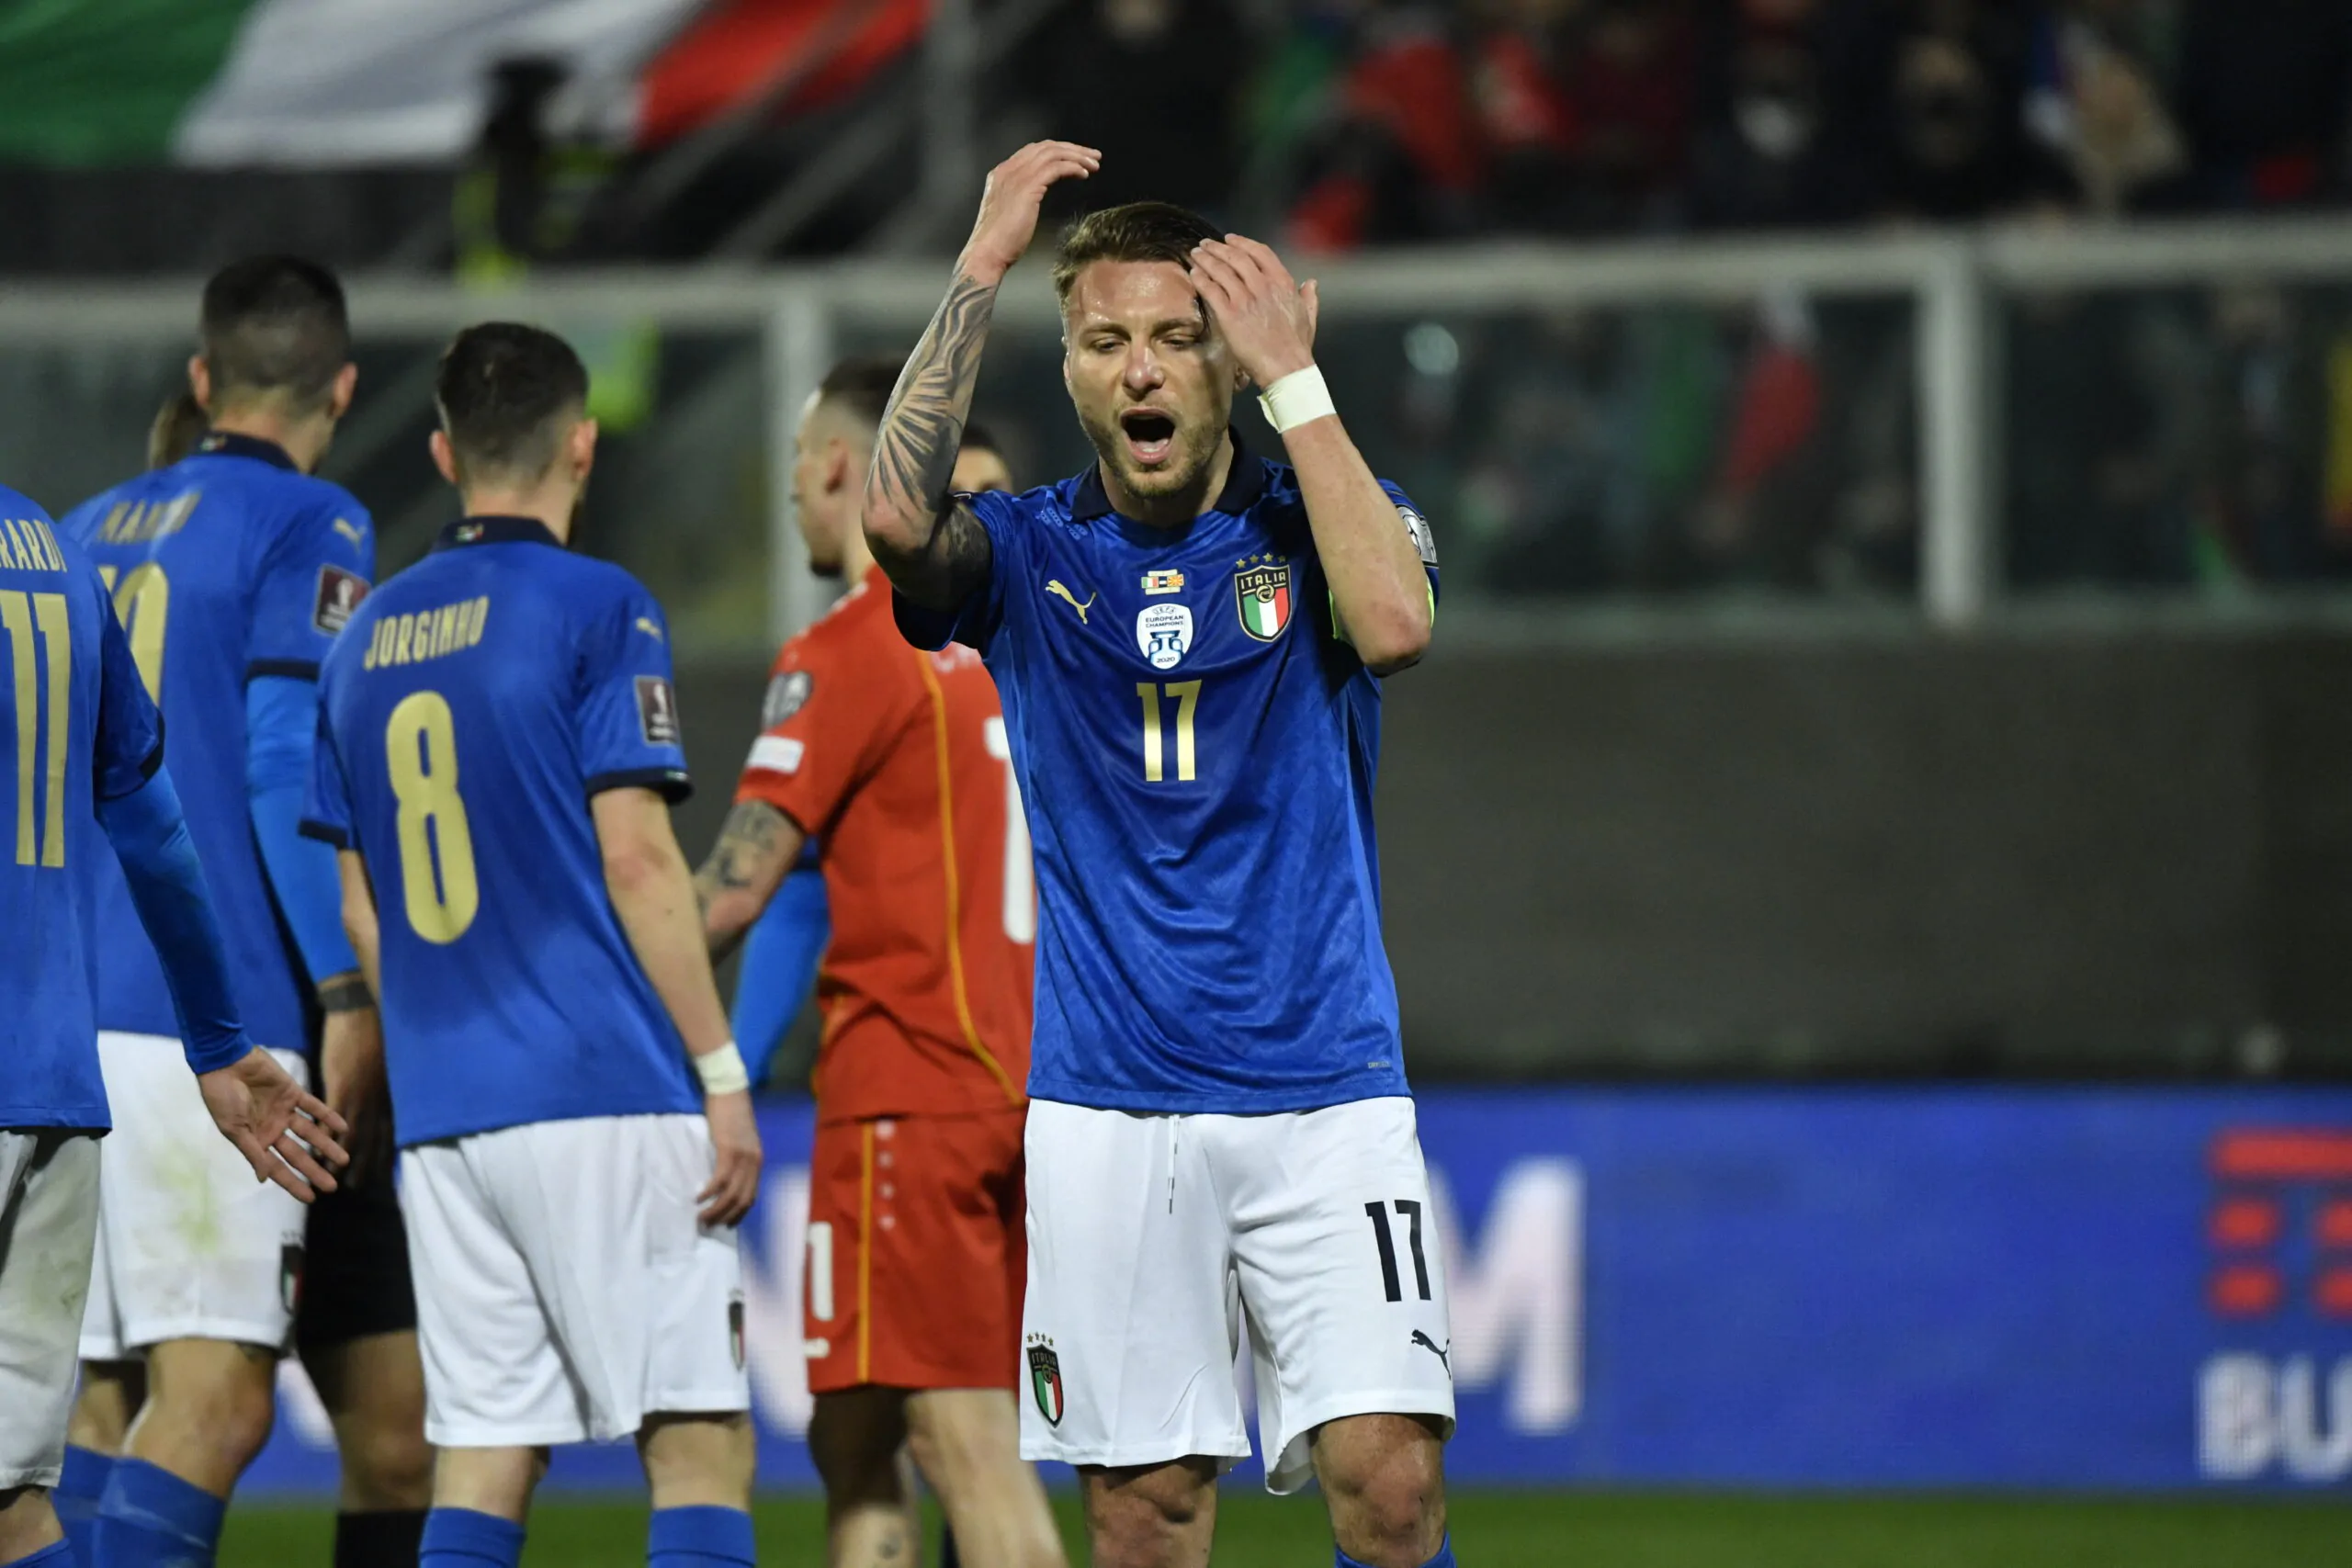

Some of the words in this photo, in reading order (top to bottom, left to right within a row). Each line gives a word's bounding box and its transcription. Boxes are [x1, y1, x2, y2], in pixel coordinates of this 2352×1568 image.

[1146, 615, 1184, 624] EUROPEAN
[1146, 620, 1184, 628] CHAMPIONS
[1240, 571, 1286, 590] ITALIA
[364, 595, 489, 671] JORGINHO
[0, 589, 72, 869] 11
[1136, 679, 1203, 782] 17
[386, 690, 480, 944] 8
[1364, 1199, 1431, 1303] 17
